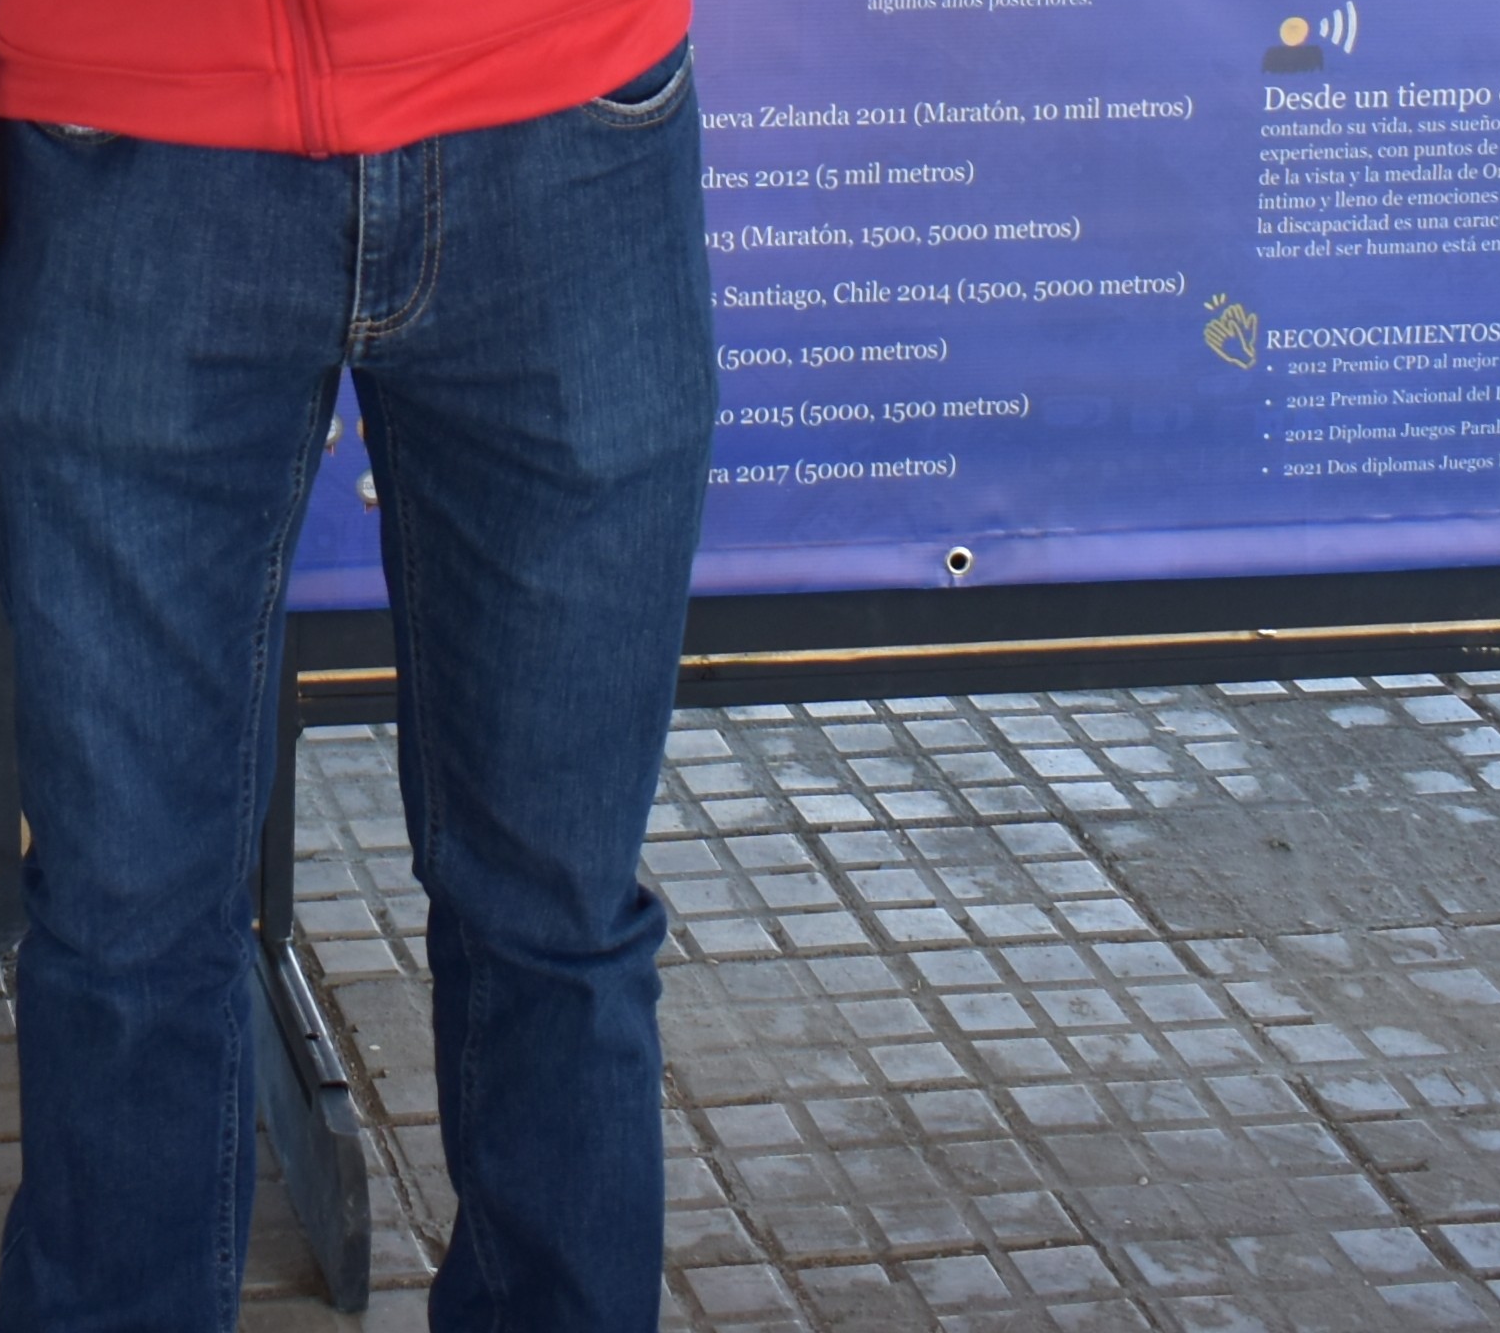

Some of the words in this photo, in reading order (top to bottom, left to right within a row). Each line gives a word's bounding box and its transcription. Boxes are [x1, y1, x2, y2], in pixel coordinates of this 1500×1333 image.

[723, 283, 827, 311] Santiago,
[833, 280, 891, 304] Chile
[897, 284, 951, 305] 2014
[957, 278, 1028, 304] (1500,
[1033, 279, 1093, 302] 5000
[1100, 271, 1185, 296] metros)
[1288, 361, 1327, 375] 2012
[1332, 355, 1390, 373] Premio
[1393, 354, 1430, 371] CPD
[1433, 352, 1448, 369] al
[1452, 352, 1500, 369] mejor
